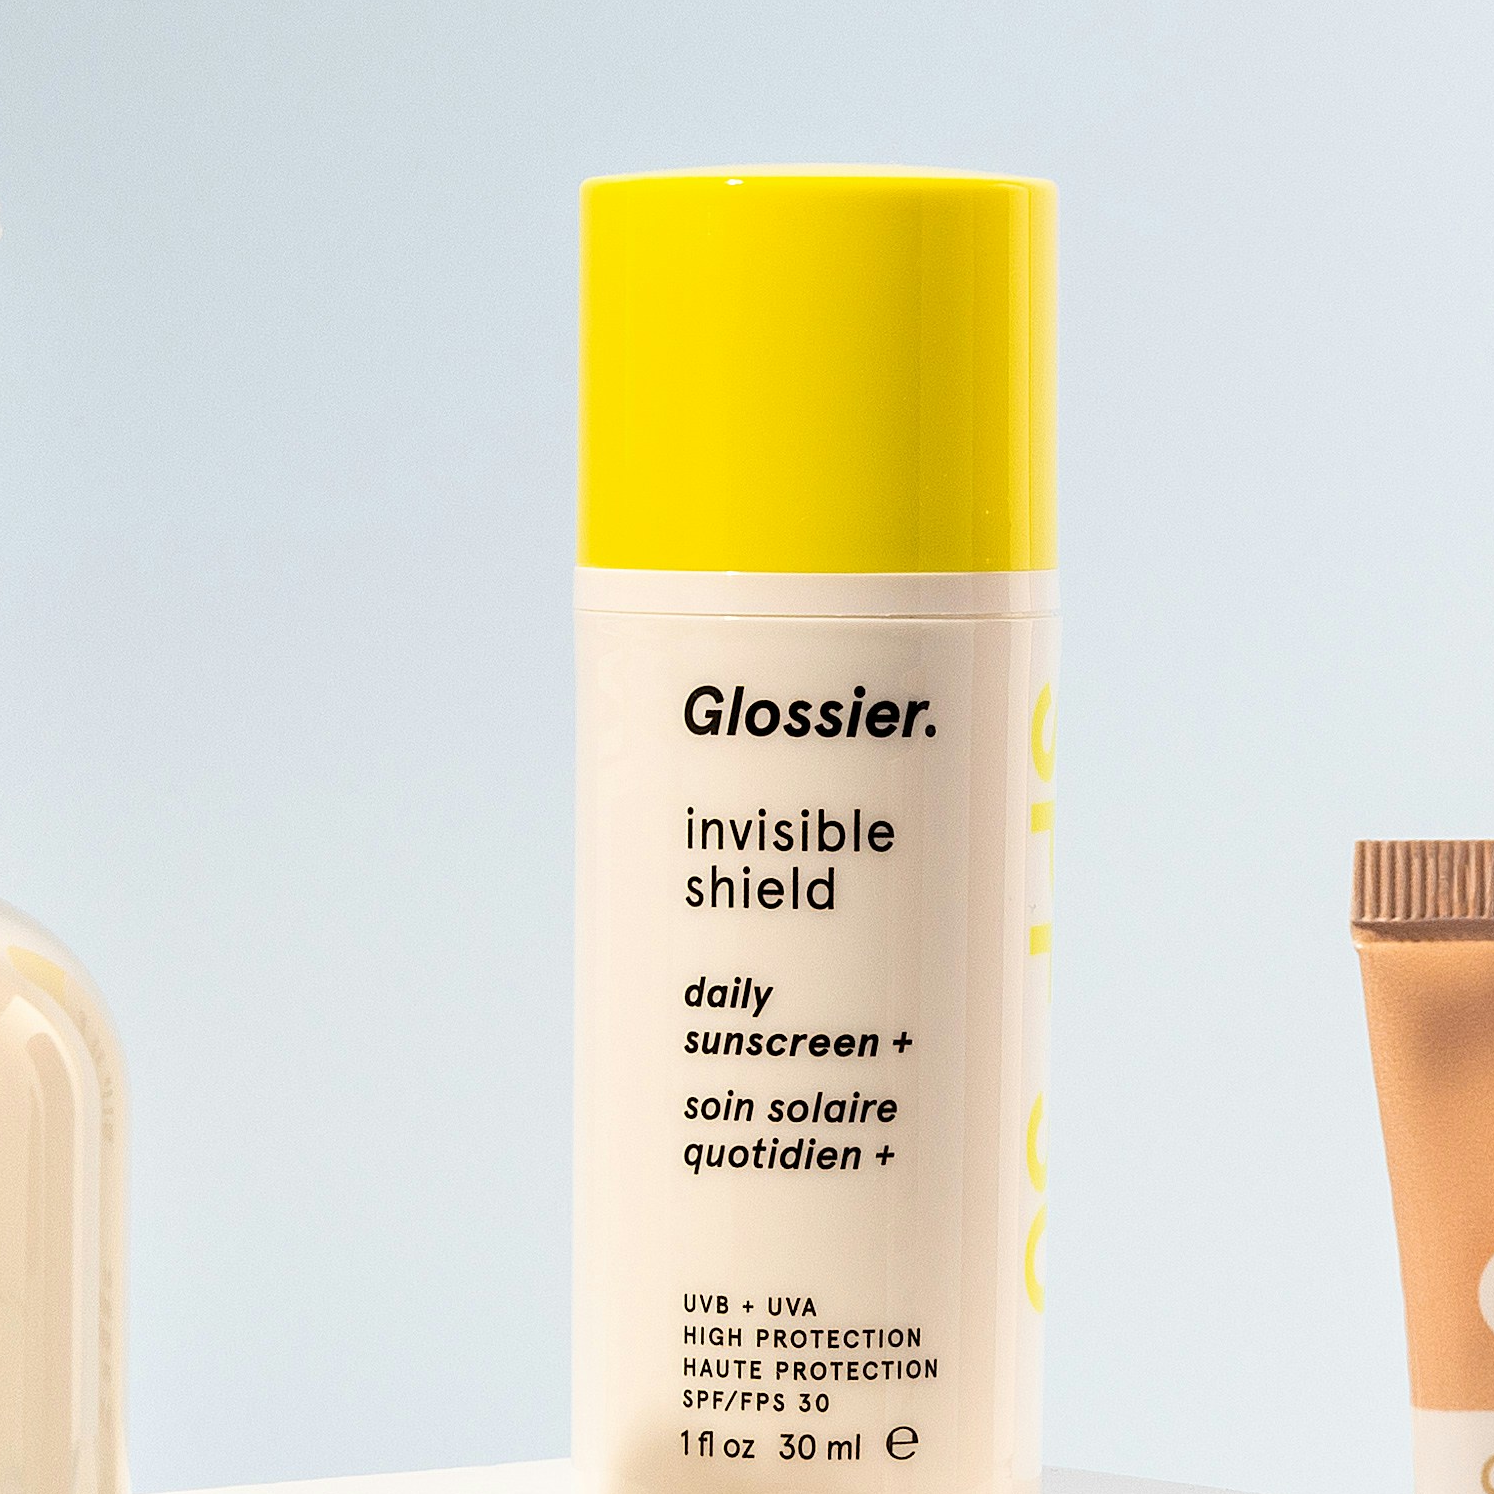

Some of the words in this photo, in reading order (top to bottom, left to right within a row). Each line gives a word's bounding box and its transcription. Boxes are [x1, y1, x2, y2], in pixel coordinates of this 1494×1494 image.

[684, 685, 936, 738] Glossier.
[687, 807, 894, 852] invisible
[686, 865, 834, 910] shield
[684, 976, 773, 1017] daily
[684, 1031, 879, 1057] sunscreen
[893, 1032, 912, 1053] +
[684, 1090, 754, 1121] soin
[768, 1092, 897, 1123] solaire
[684, 1138, 861, 1175] quotidien
[876, 1145, 894, 1165] +
[684, 1294, 729, 1314] UVB
[743, 1301, 754, 1313] +
[768, 1297, 816, 1316] UVA
[684, 1326, 741, 1347] HIGH
[757, 1328, 920, 1349] PROTECTION
[684, 1358, 761, 1380] HAUTE
[776, 1359, 937, 1381] PROTECTION
[683, 1389, 785, 1412] SPF/FPS
[799, 1393, 829, 1413] 30
[681, 1430, 689, 1455] 1
[698, 1431, 713, 1457] fl
[723, 1439, 755, 1459] oz
[779, 1434, 816, 1460] 30
[828, 1434, 861, 1460] ml
